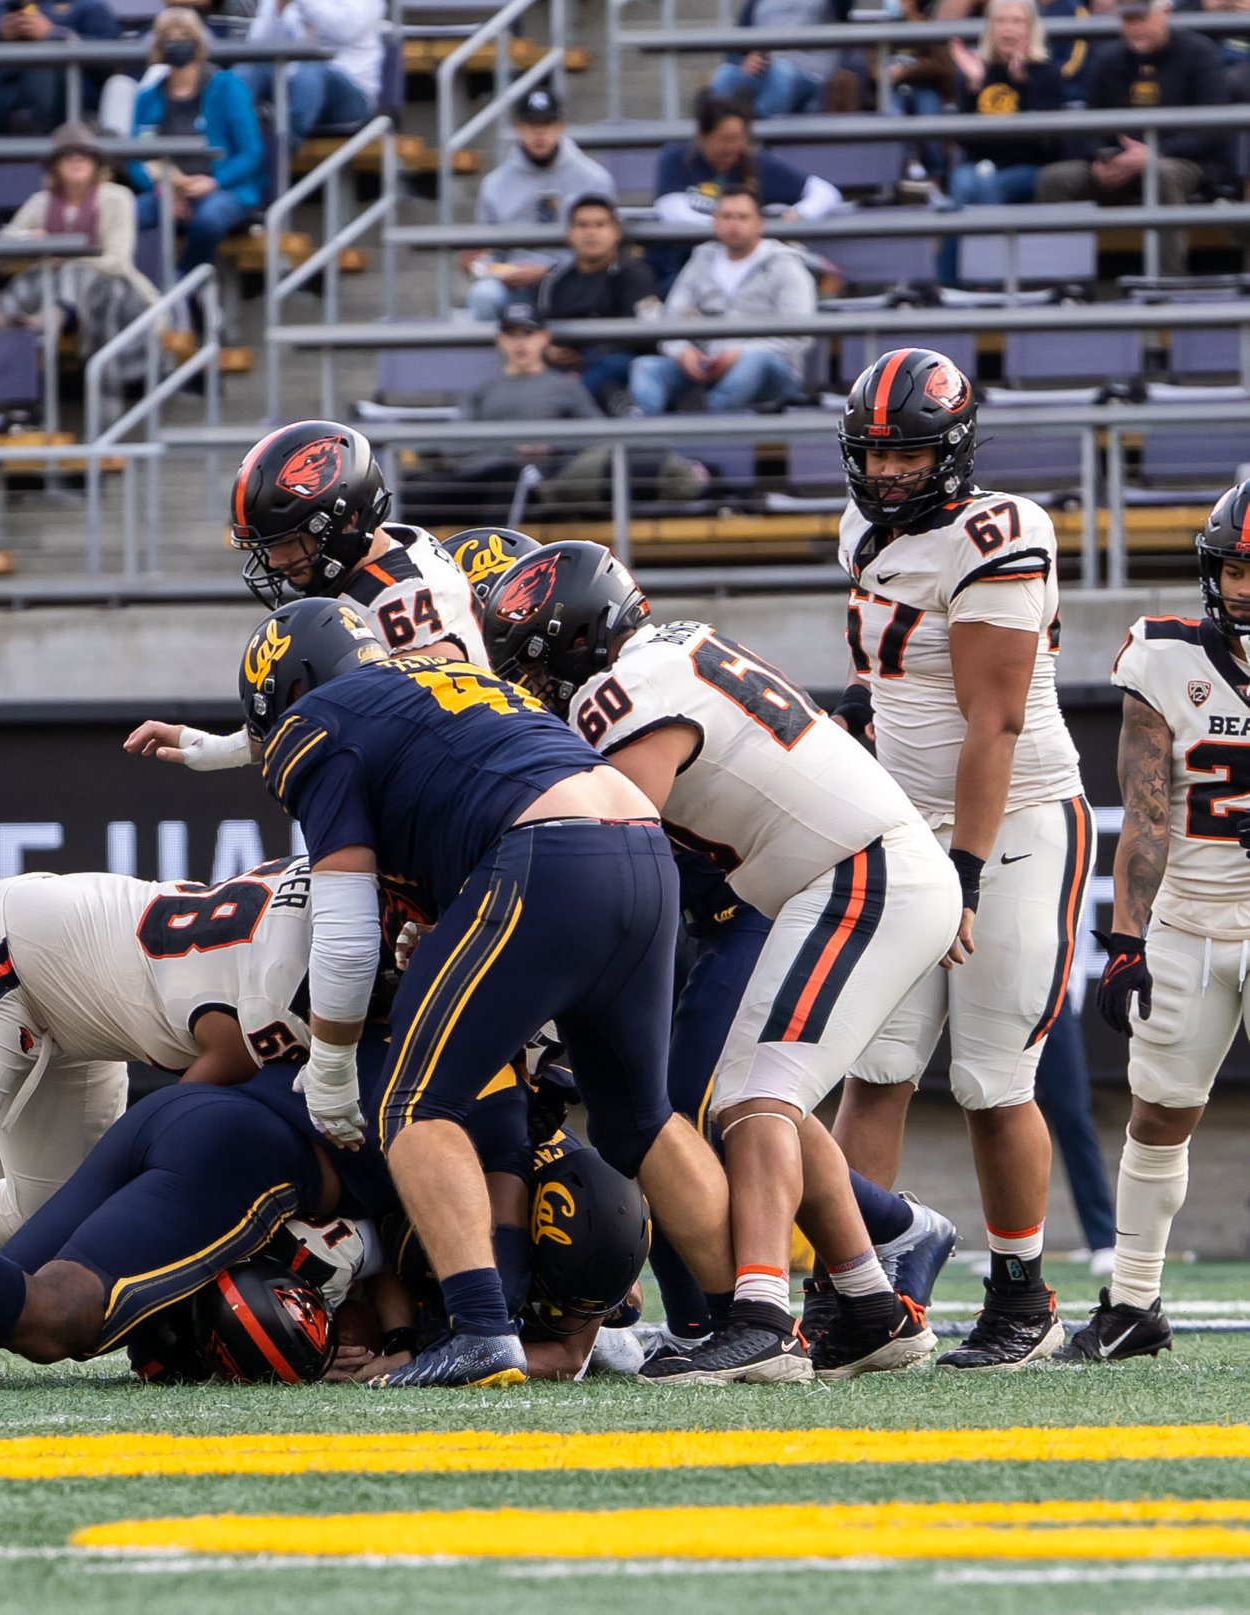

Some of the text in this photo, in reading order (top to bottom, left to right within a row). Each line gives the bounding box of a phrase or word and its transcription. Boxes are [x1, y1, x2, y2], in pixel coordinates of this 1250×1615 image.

[453, 534, 518, 584] Cal
[964, 501, 1023, 558] 67
[377, 588, 443, 649] 64
[244, 618, 291, 692] Cal
[576, 676, 634, 748] 60
[690, 627, 826, 752] 6
[270, 862, 312, 910] PER
[531, 1181, 575, 1246] Cal
